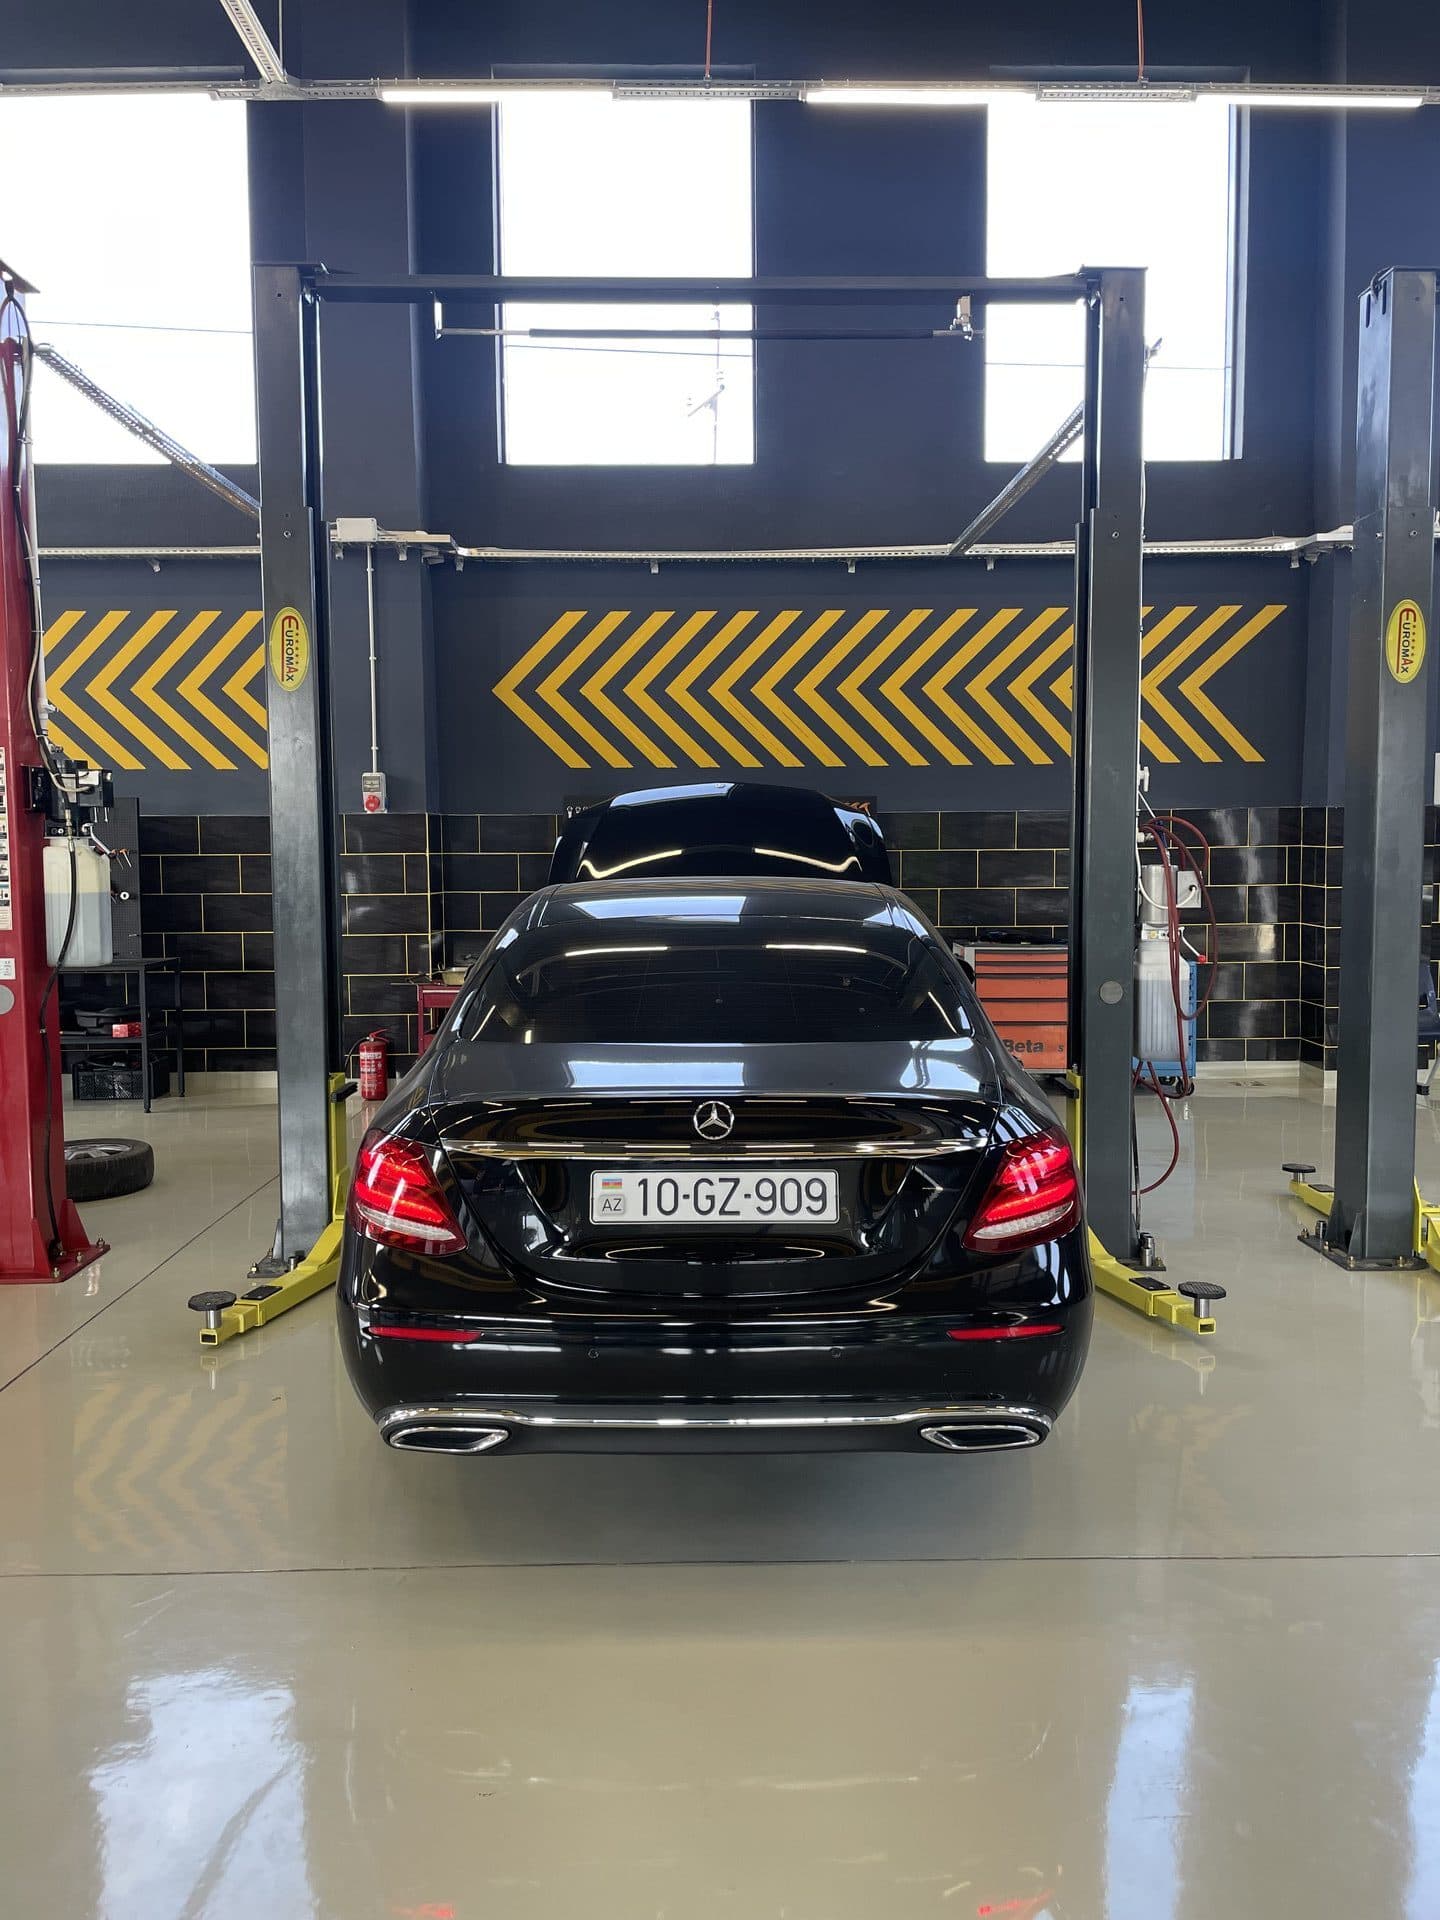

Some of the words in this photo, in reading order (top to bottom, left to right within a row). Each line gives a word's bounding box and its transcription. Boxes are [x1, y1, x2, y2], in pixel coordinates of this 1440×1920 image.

[281, 615, 299, 682] EUROMAX
[1396, 608, 1417, 674] EUROMAX
[602, 1199, 622, 1212] AZ
[638, 1178, 827, 1216] 10-GZ-909
